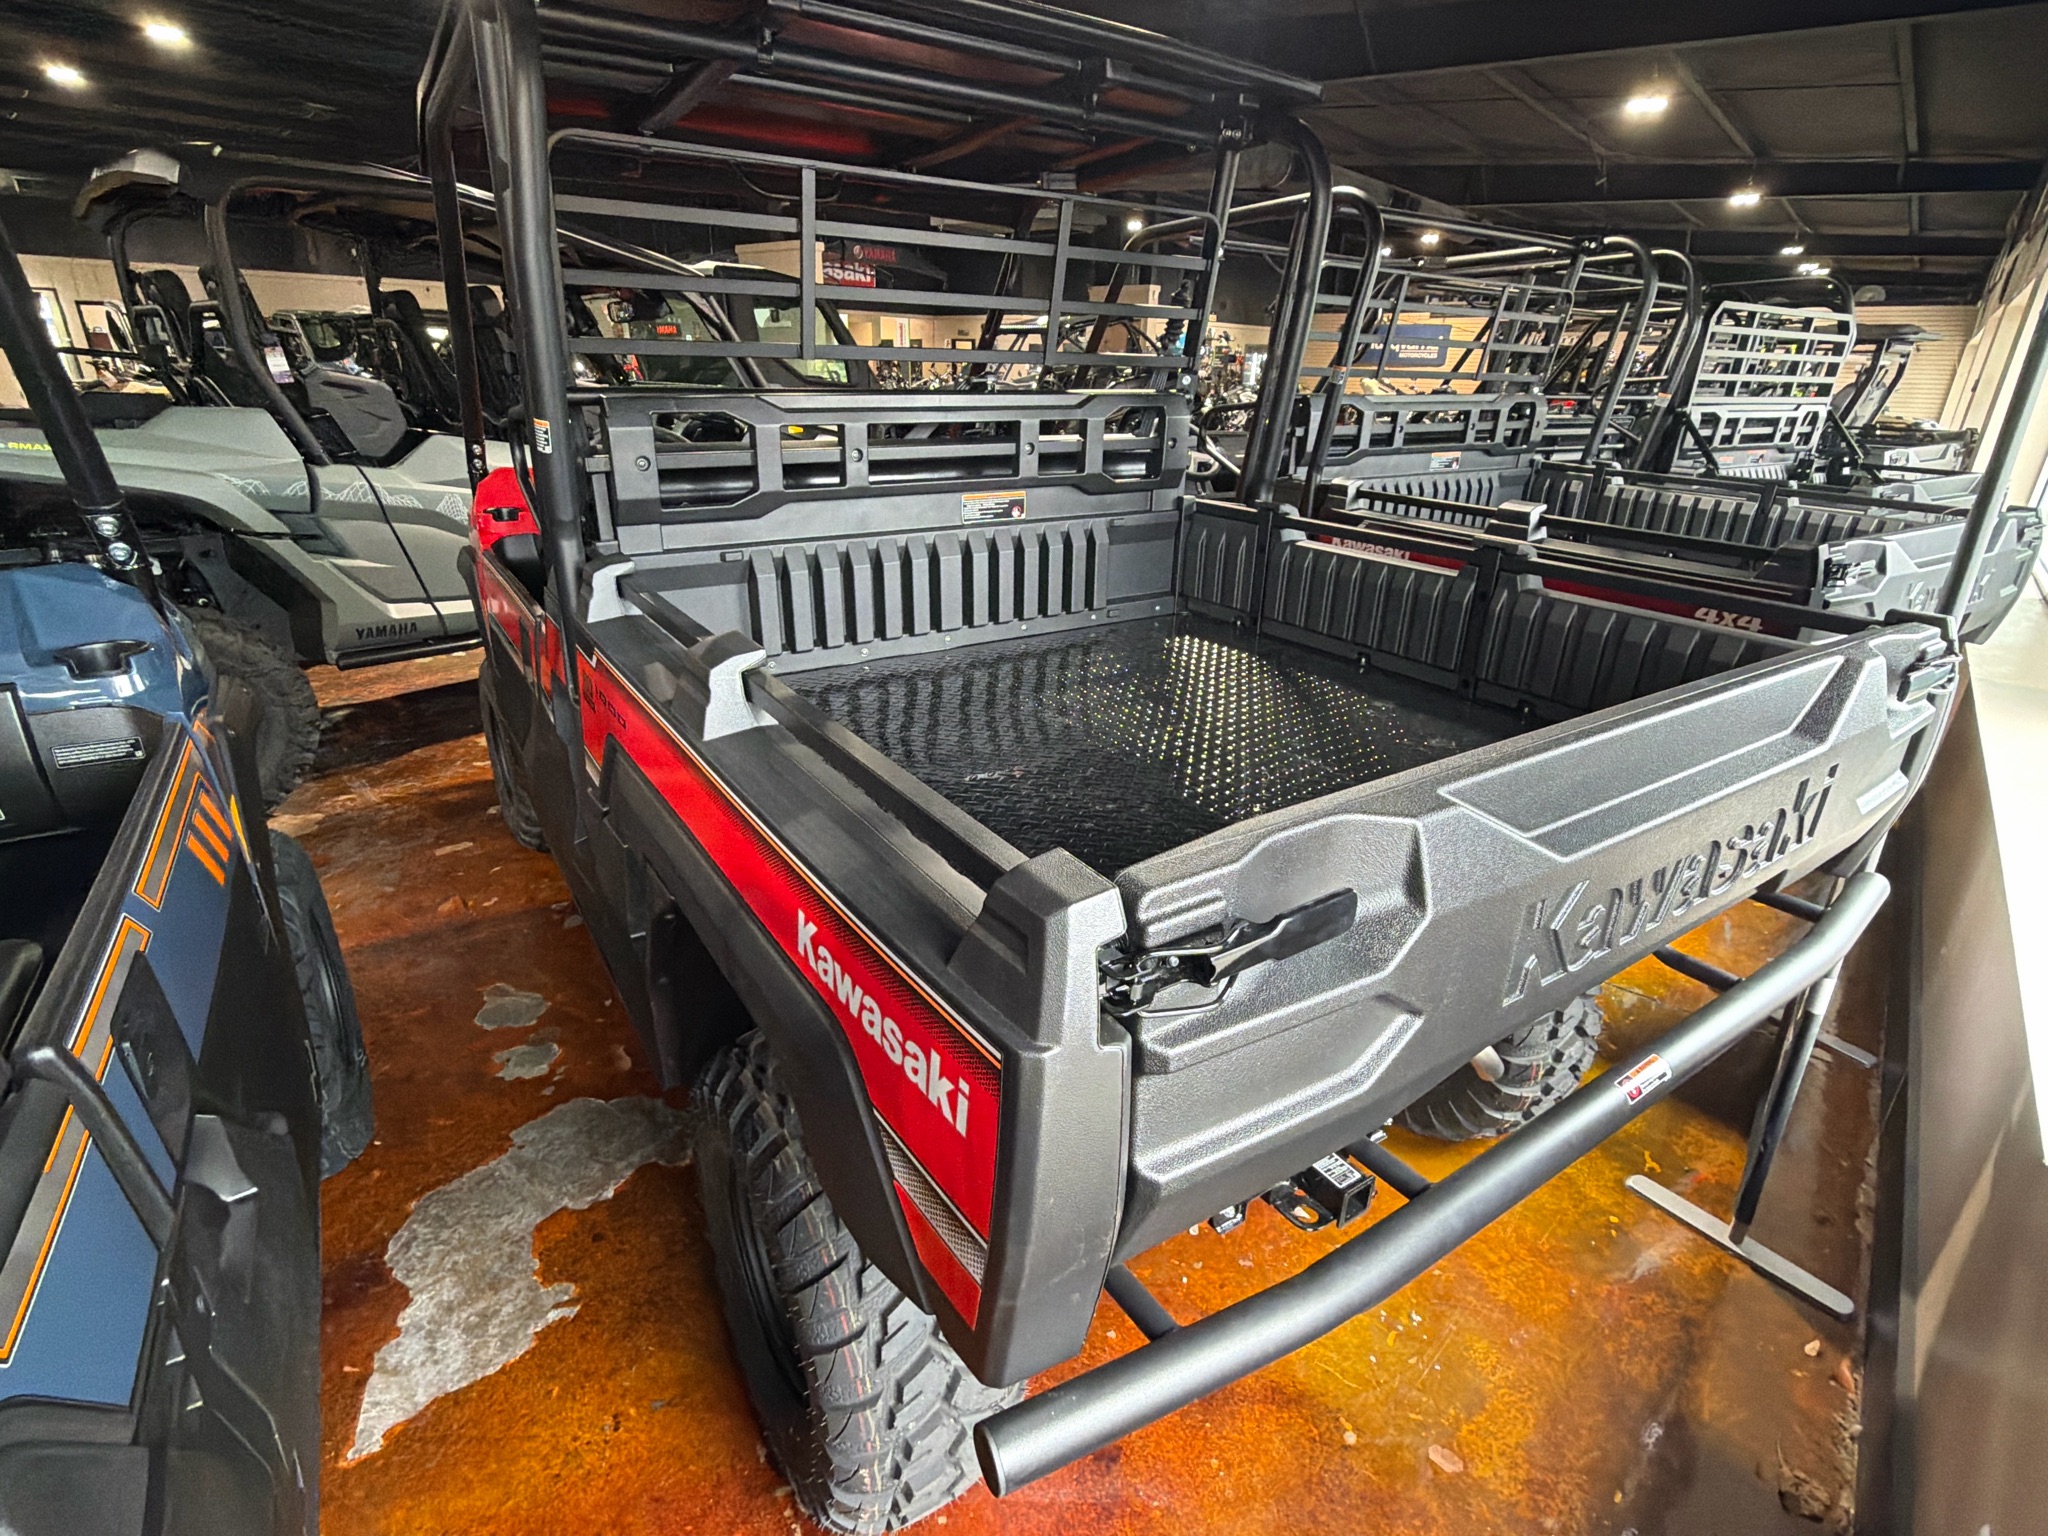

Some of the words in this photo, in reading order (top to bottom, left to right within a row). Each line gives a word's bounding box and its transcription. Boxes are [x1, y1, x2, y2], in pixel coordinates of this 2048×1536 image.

[356, 622, 417, 640] YAMAHA
[1502, 763, 1839, 1007] Kawasaki
[797, 908, 970, 1138] Kawasaki
